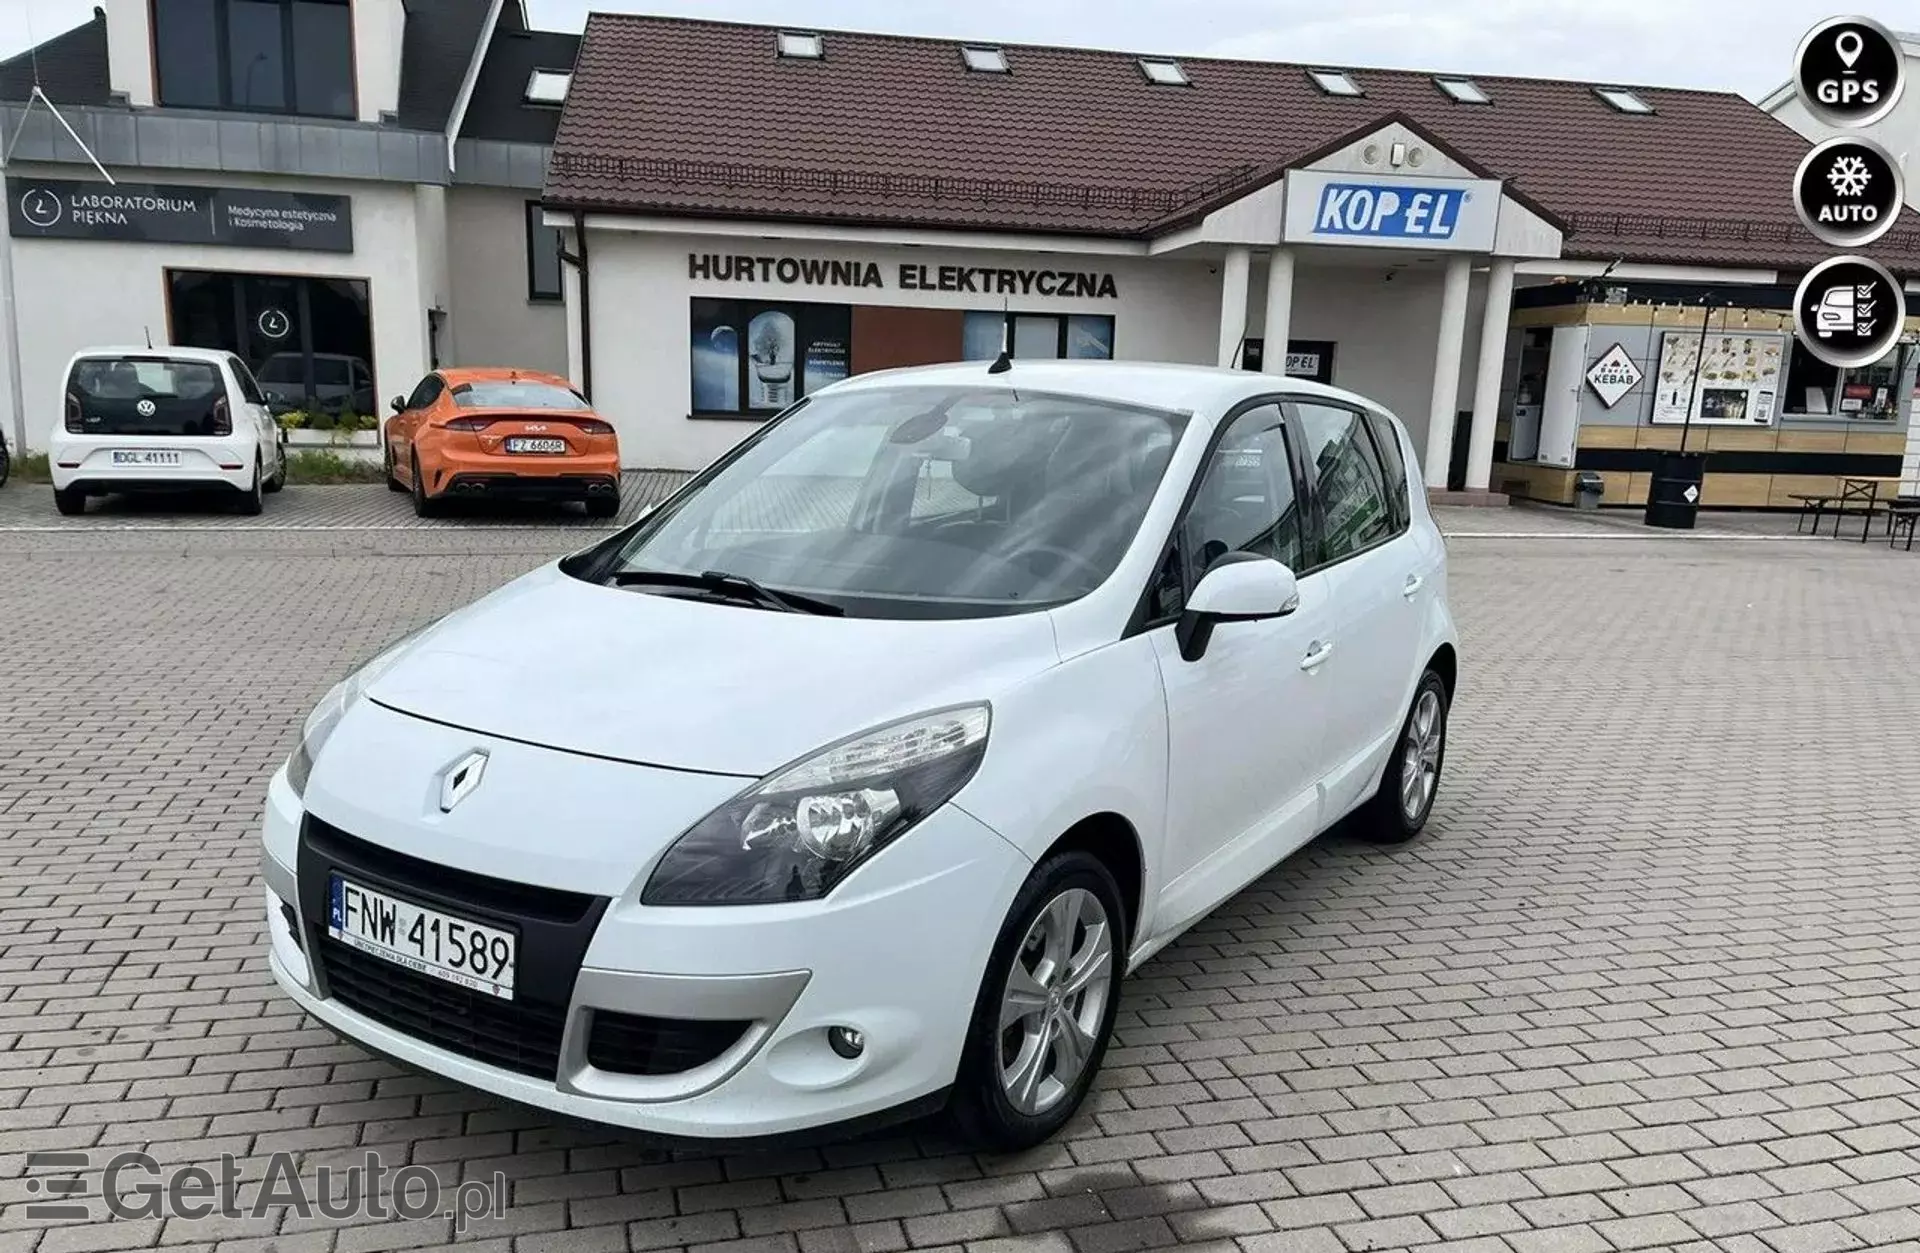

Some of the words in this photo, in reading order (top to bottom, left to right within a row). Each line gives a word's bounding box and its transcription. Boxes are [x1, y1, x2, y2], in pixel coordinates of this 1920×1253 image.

[71, 195, 197, 212] LABORATORIUM
[72, 210, 129, 226] PIĘKNA
[227, 205, 279, 218] Medycyna
[281, 209, 337, 222] estetyczna
[234, 217, 305, 231] Kosmetologia
[688, 253, 883, 288] HURTOWNIA
[898, 264, 1118, 298] ELEKTRYCZNA
[1594, 374, 1634, 385] KEBAB
[513, 440, 527, 450] FZ
[530, 440, 562, 450] 6606R
[121, 452, 143, 463] DGL
[144, 452, 179, 463] 41111
[333, 907, 342, 921] PL
[345, 887, 396, 946] FNW
[408, 913, 511, 980] 41589
